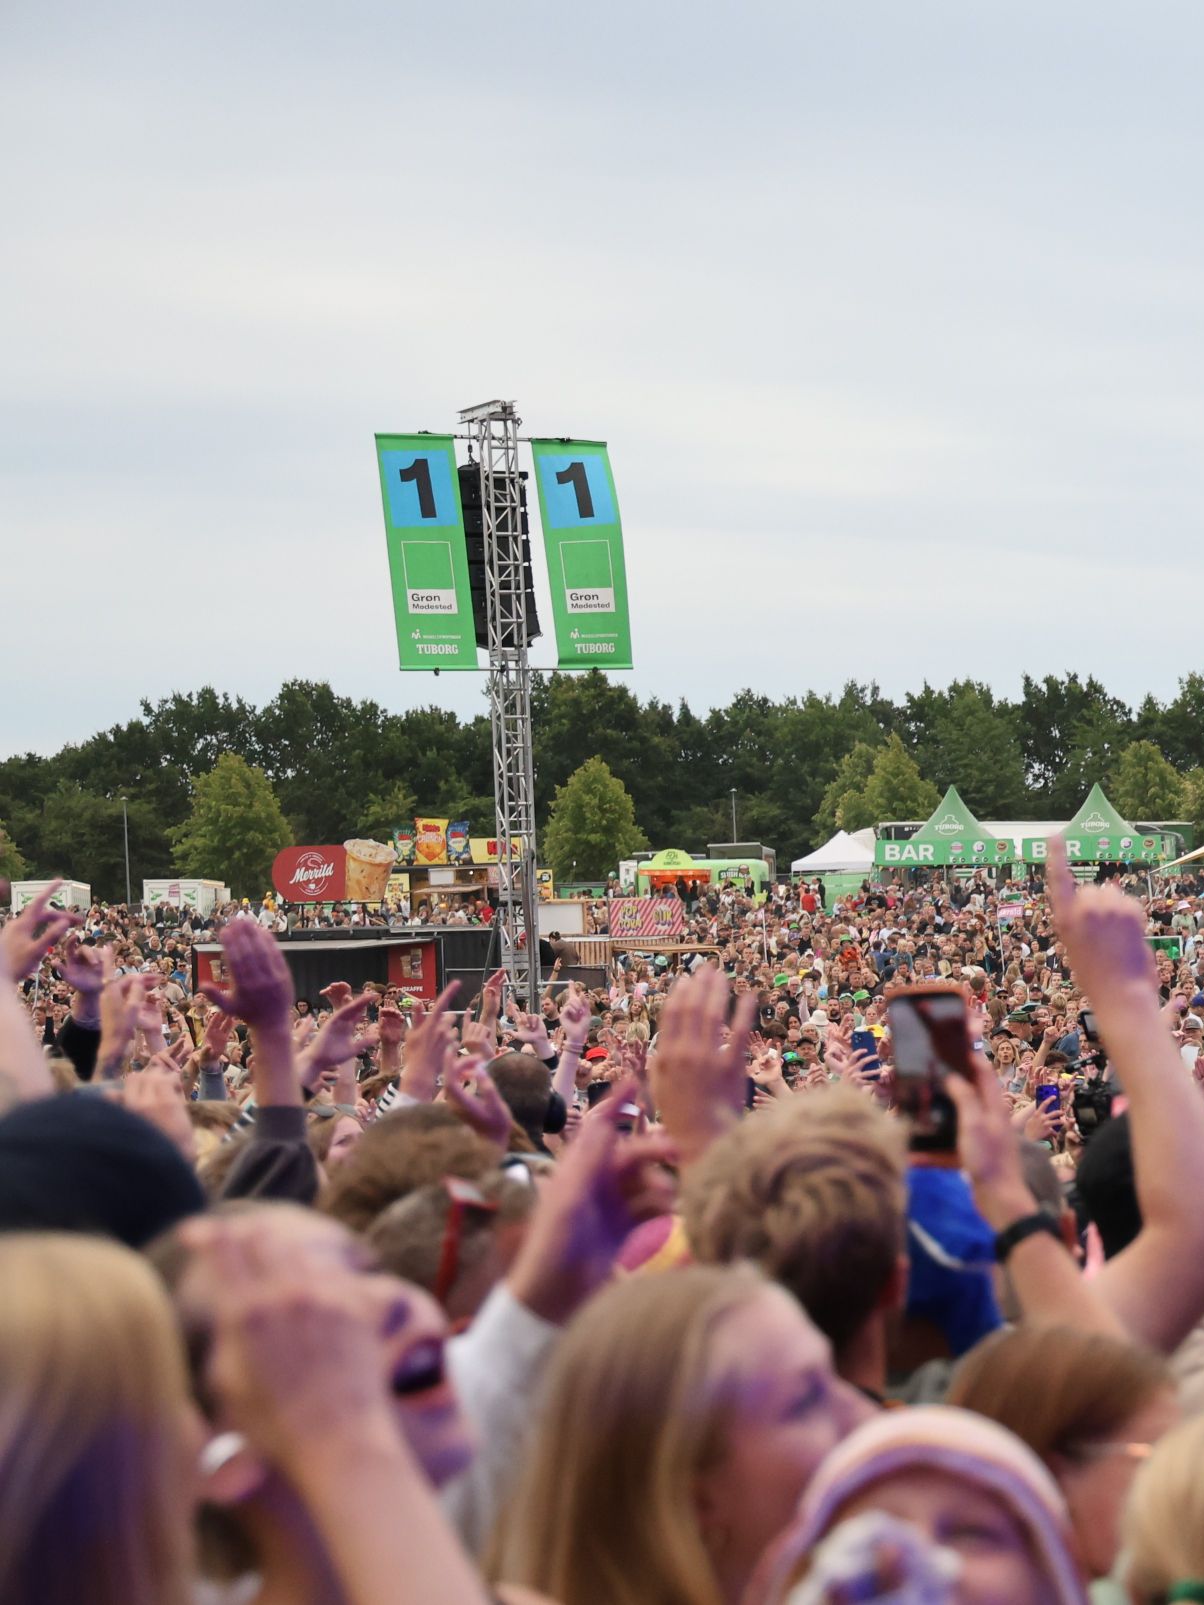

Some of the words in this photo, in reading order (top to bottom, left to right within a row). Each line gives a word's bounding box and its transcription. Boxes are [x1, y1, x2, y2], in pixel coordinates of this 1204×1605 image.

[399, 458, 437, 518] 1
[555, 462, 595, 518] 1
[416, 644, 458, 654] TUBORG
[575, 643, 615, 653] TUBORG
[885, 844, 934, 861] BAR
[1032, 840, 1081, 858] BR
[289, 862, 334, 884] Merrild
[620, 905, 638, 918] POP
